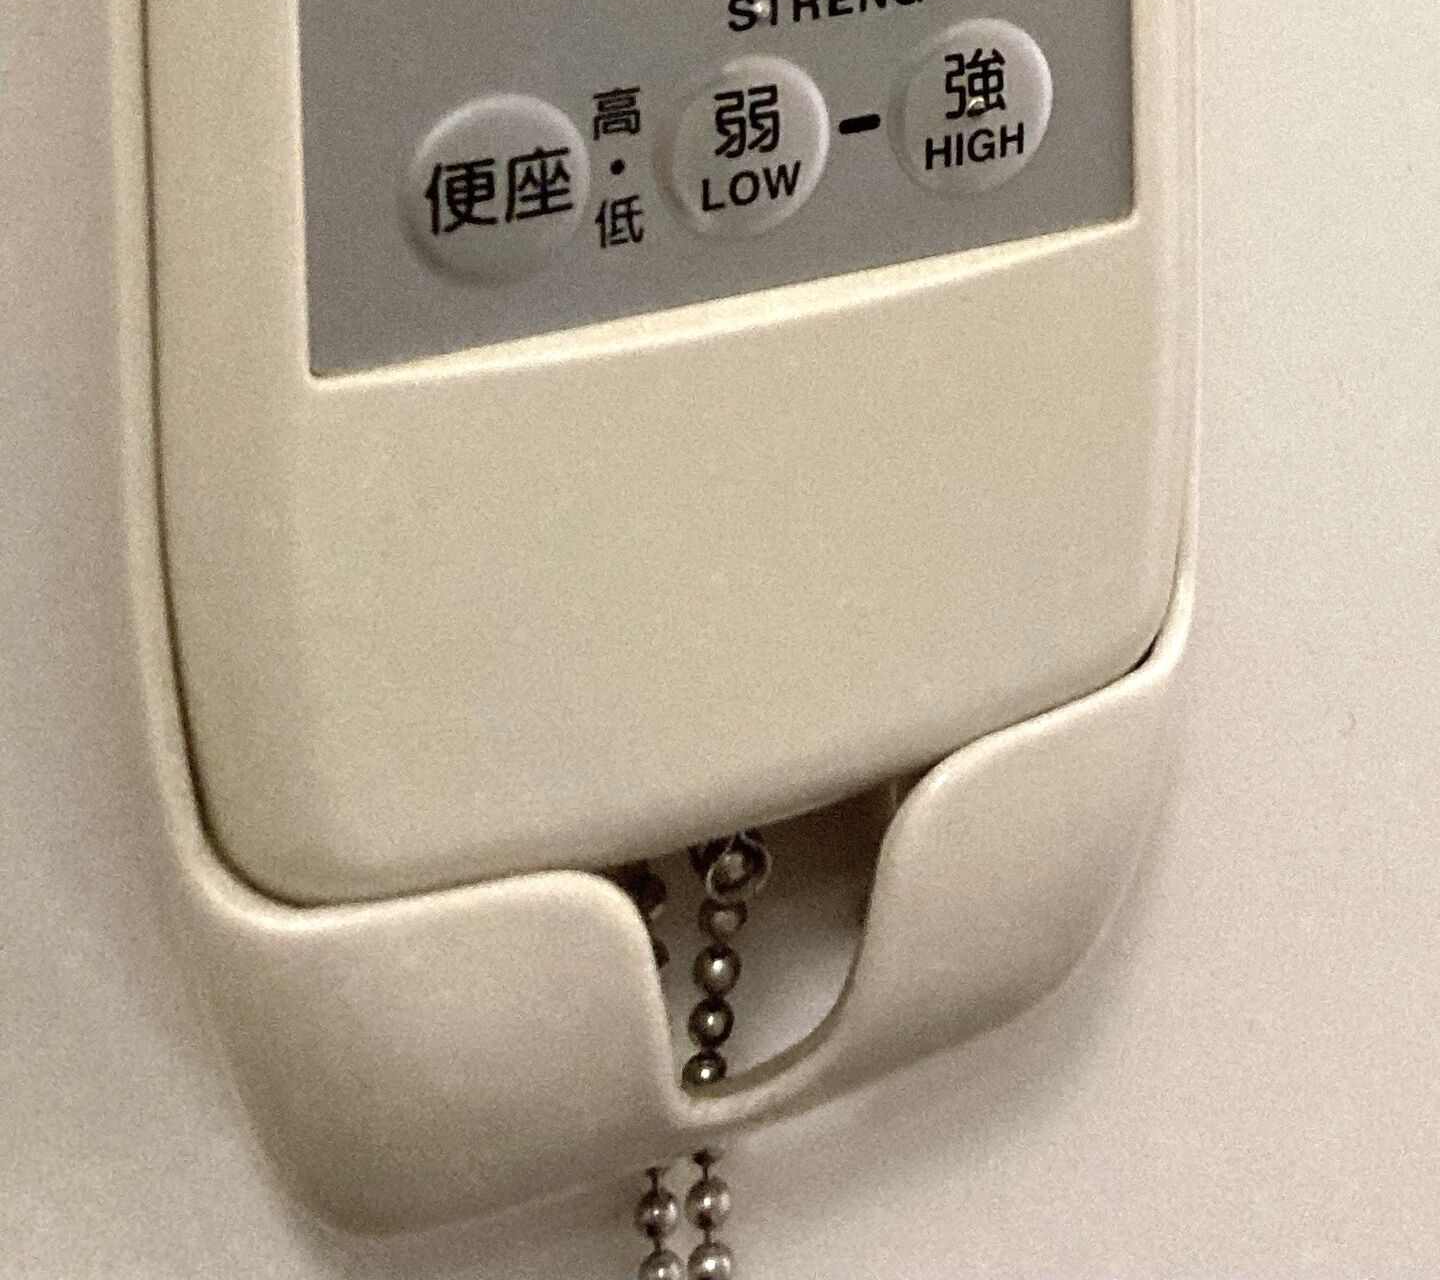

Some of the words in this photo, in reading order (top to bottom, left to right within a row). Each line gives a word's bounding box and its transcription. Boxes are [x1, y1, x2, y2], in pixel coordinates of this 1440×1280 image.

[945, 48, 1007, 121] 強
[714, 86, 780, 157] 弱
[925, 123, 1026, 171] HIGH
[424, 148, 574, 235] 便座
[702, 161, 801, 212] LOW
